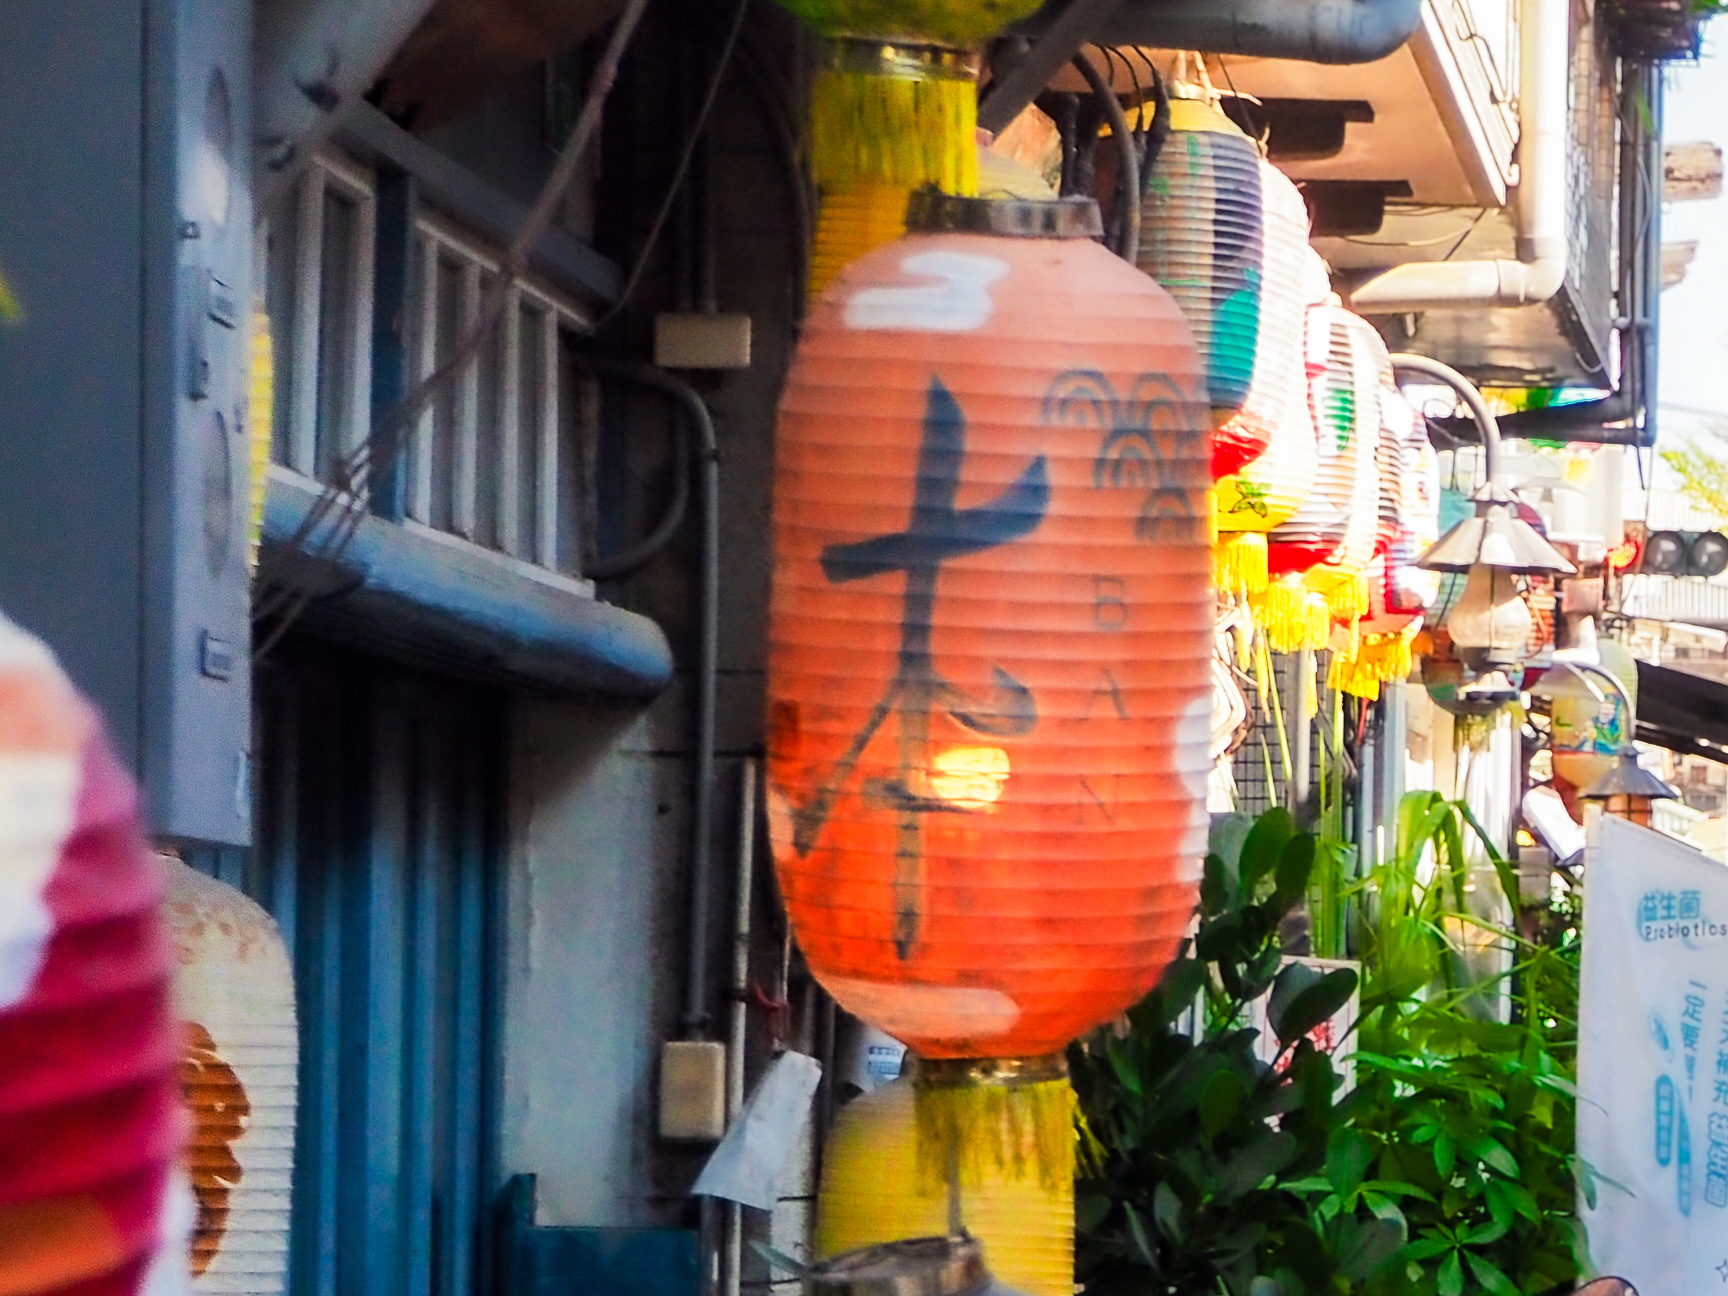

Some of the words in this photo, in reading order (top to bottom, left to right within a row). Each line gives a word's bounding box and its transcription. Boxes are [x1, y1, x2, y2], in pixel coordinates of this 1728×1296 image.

[1643, 890, 1700, 921] 益生菌
[1645, 921, 1728, 942] Probiotics
